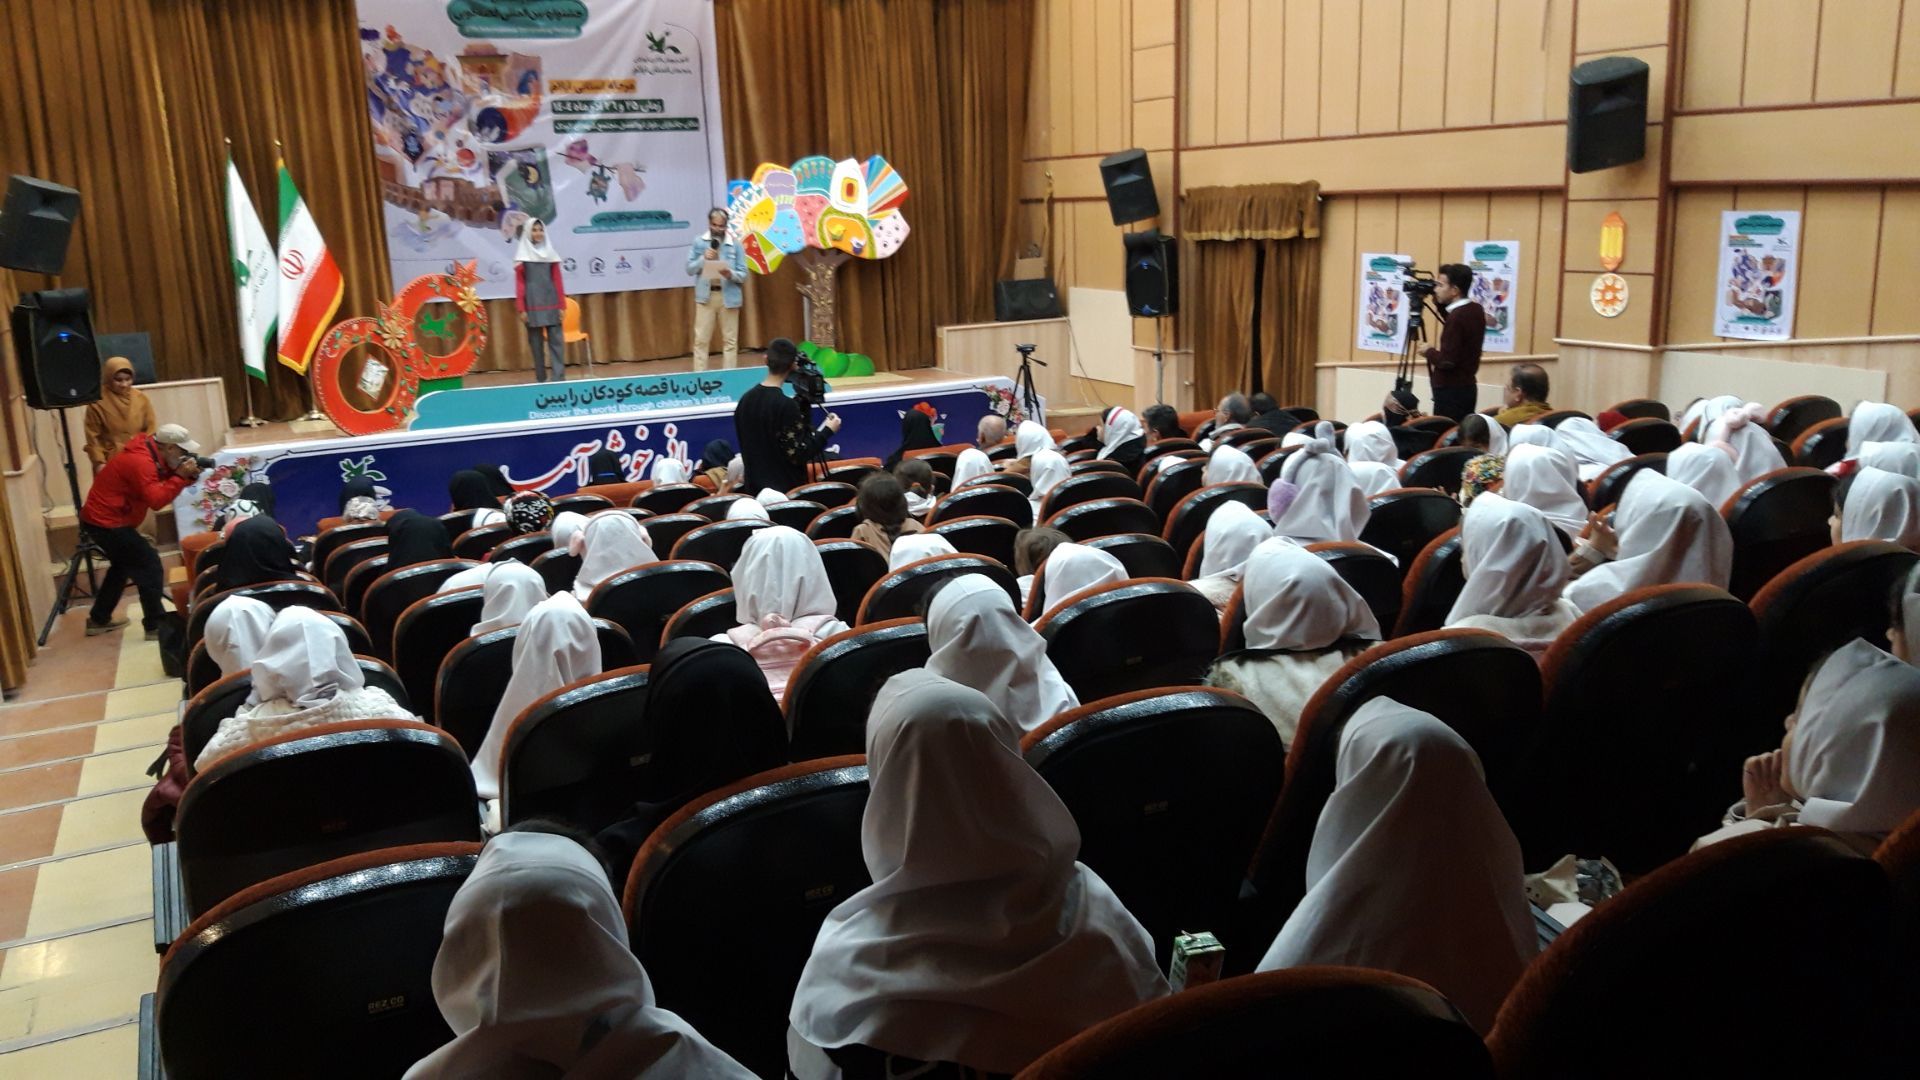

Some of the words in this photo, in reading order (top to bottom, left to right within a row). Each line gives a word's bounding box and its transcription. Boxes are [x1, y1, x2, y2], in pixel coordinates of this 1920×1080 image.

[580, 383, 634, 405] کودکان
[634, 378, 669, 396] قصه
[670, 379, 681, 398] با
[535, 393, 568, 409] ببین
[568, 388, 579, 407] را
[529, 409, 571, 420] Discover
[573, 407, 590, 415] the
[591, 404, 618, 415] world
[621, 402, 655, 413] through
[702, 395, 732, 405] stories
